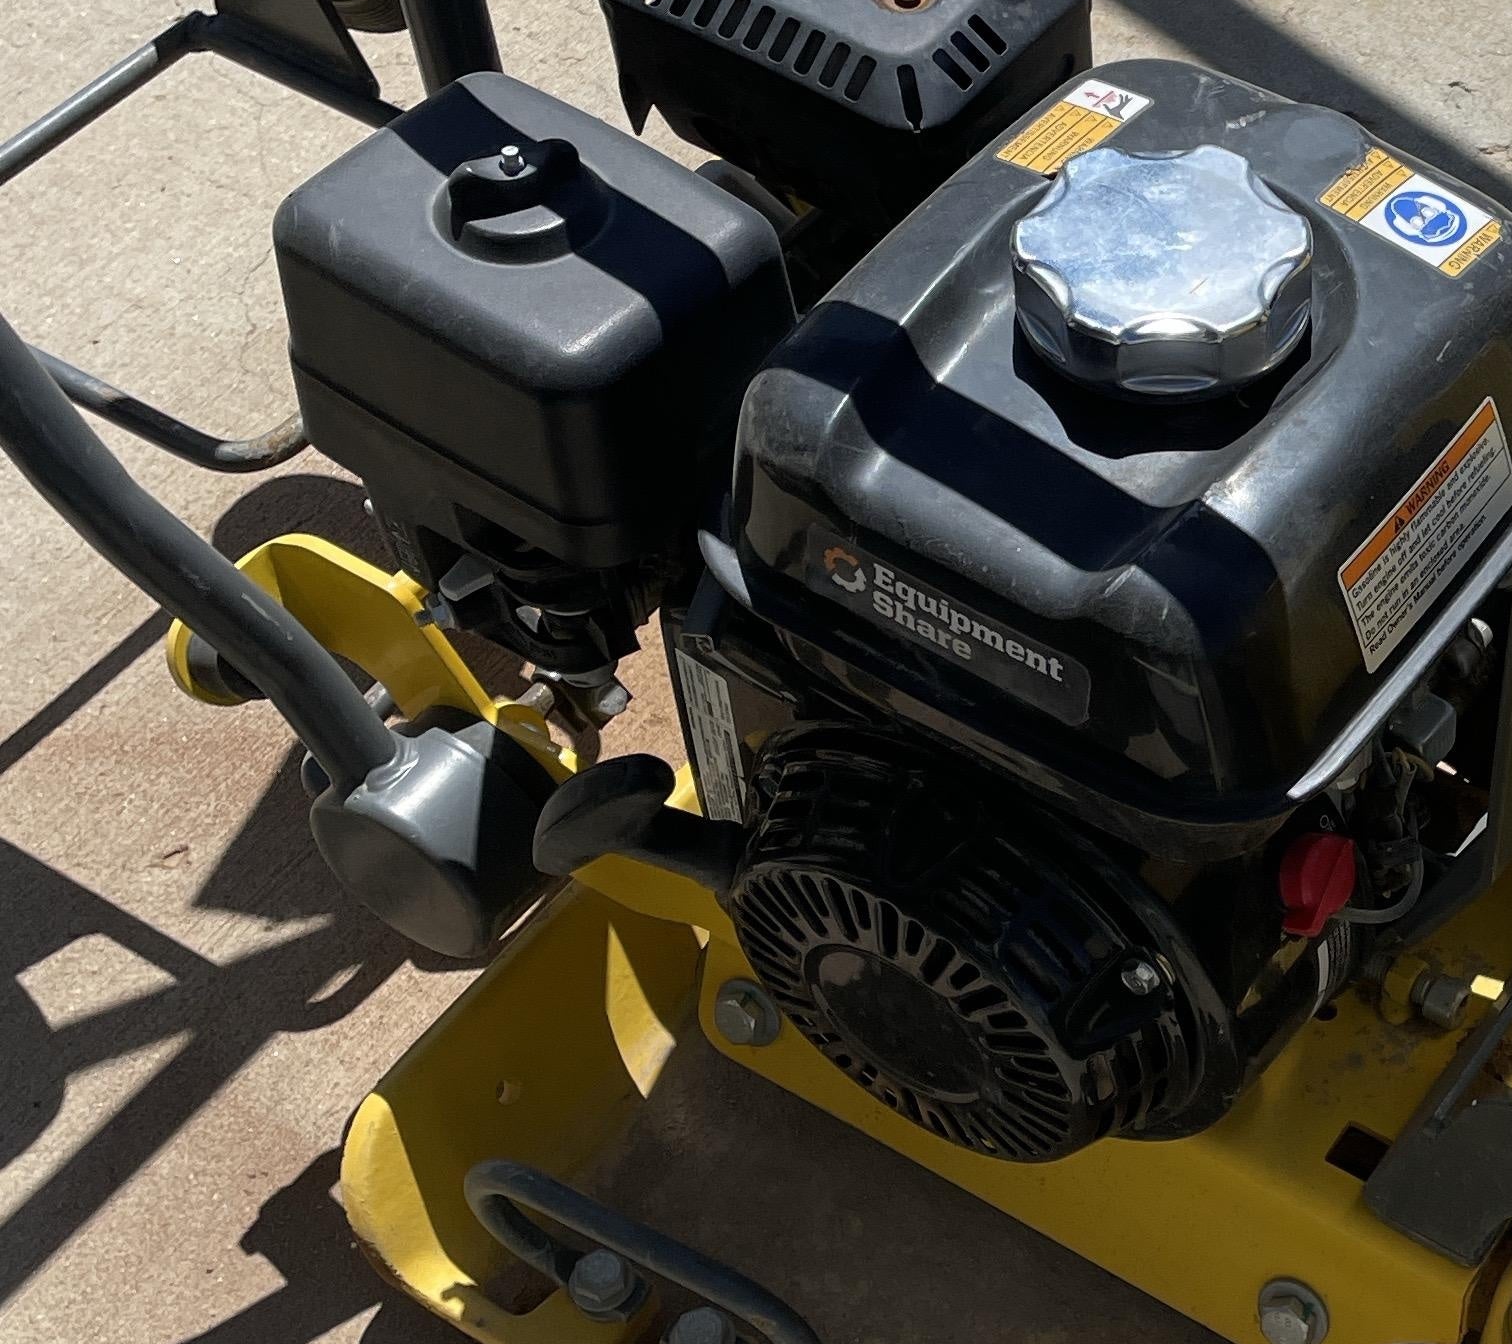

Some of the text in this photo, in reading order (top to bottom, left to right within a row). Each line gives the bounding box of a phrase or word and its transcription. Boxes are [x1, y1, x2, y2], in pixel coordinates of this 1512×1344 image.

[1020, 120, 1068, 161] ADVERTENCIA
[1341, 169, 1383, 207] ADVERTENCIA
[1449, 232, 1493, 271] WARNING
[1352, 562, 1381, 599] Gasoline
[1383, 553, 1388, 563] is
[1390, 529, 1409, 557] highly
[1411, 487, 1444, 531] flammable
[1446, 472, 1457, 489] and
[1407, 460, 1449, 515] WARNING
[1357, 591, 1372, 612] Turn
[1374, 564, 1396, 595] engine
[1397, 551, 1406, 564] off
[1408, 535, 1420, 552] and
[1422, 523, 1430, 536] let
[1431, 505, 1444, 524] cool
[1446, 480, 1466, 507] before
[1362, 609, 1374, 627] The
[1376, 582, 1398, 613] engine
[1400, 558, 1417, 582] emits
[1419, 538, 1434, 560] toxic
[1436, 510, 1457, 540] carbon
[1366, 627, 1374, 640] Do
[1377, 611, 1387, 627] not
[1389, 596, 1400, 613] run
[1402, 587, 1408, 597] in
[1409, 575, 1418, 588] an
[1419, 541, 1446, 576] enclosed
[872, 590, 972, 662] Share
[873, 562, 1064, 682] Equipment
[1370, 632, 1386, 654] Read
[1388, 601, 1412, 633] Owner's
[1413, 573, 1435, 602] Manual
[1437, 548, 1456, 574] before
